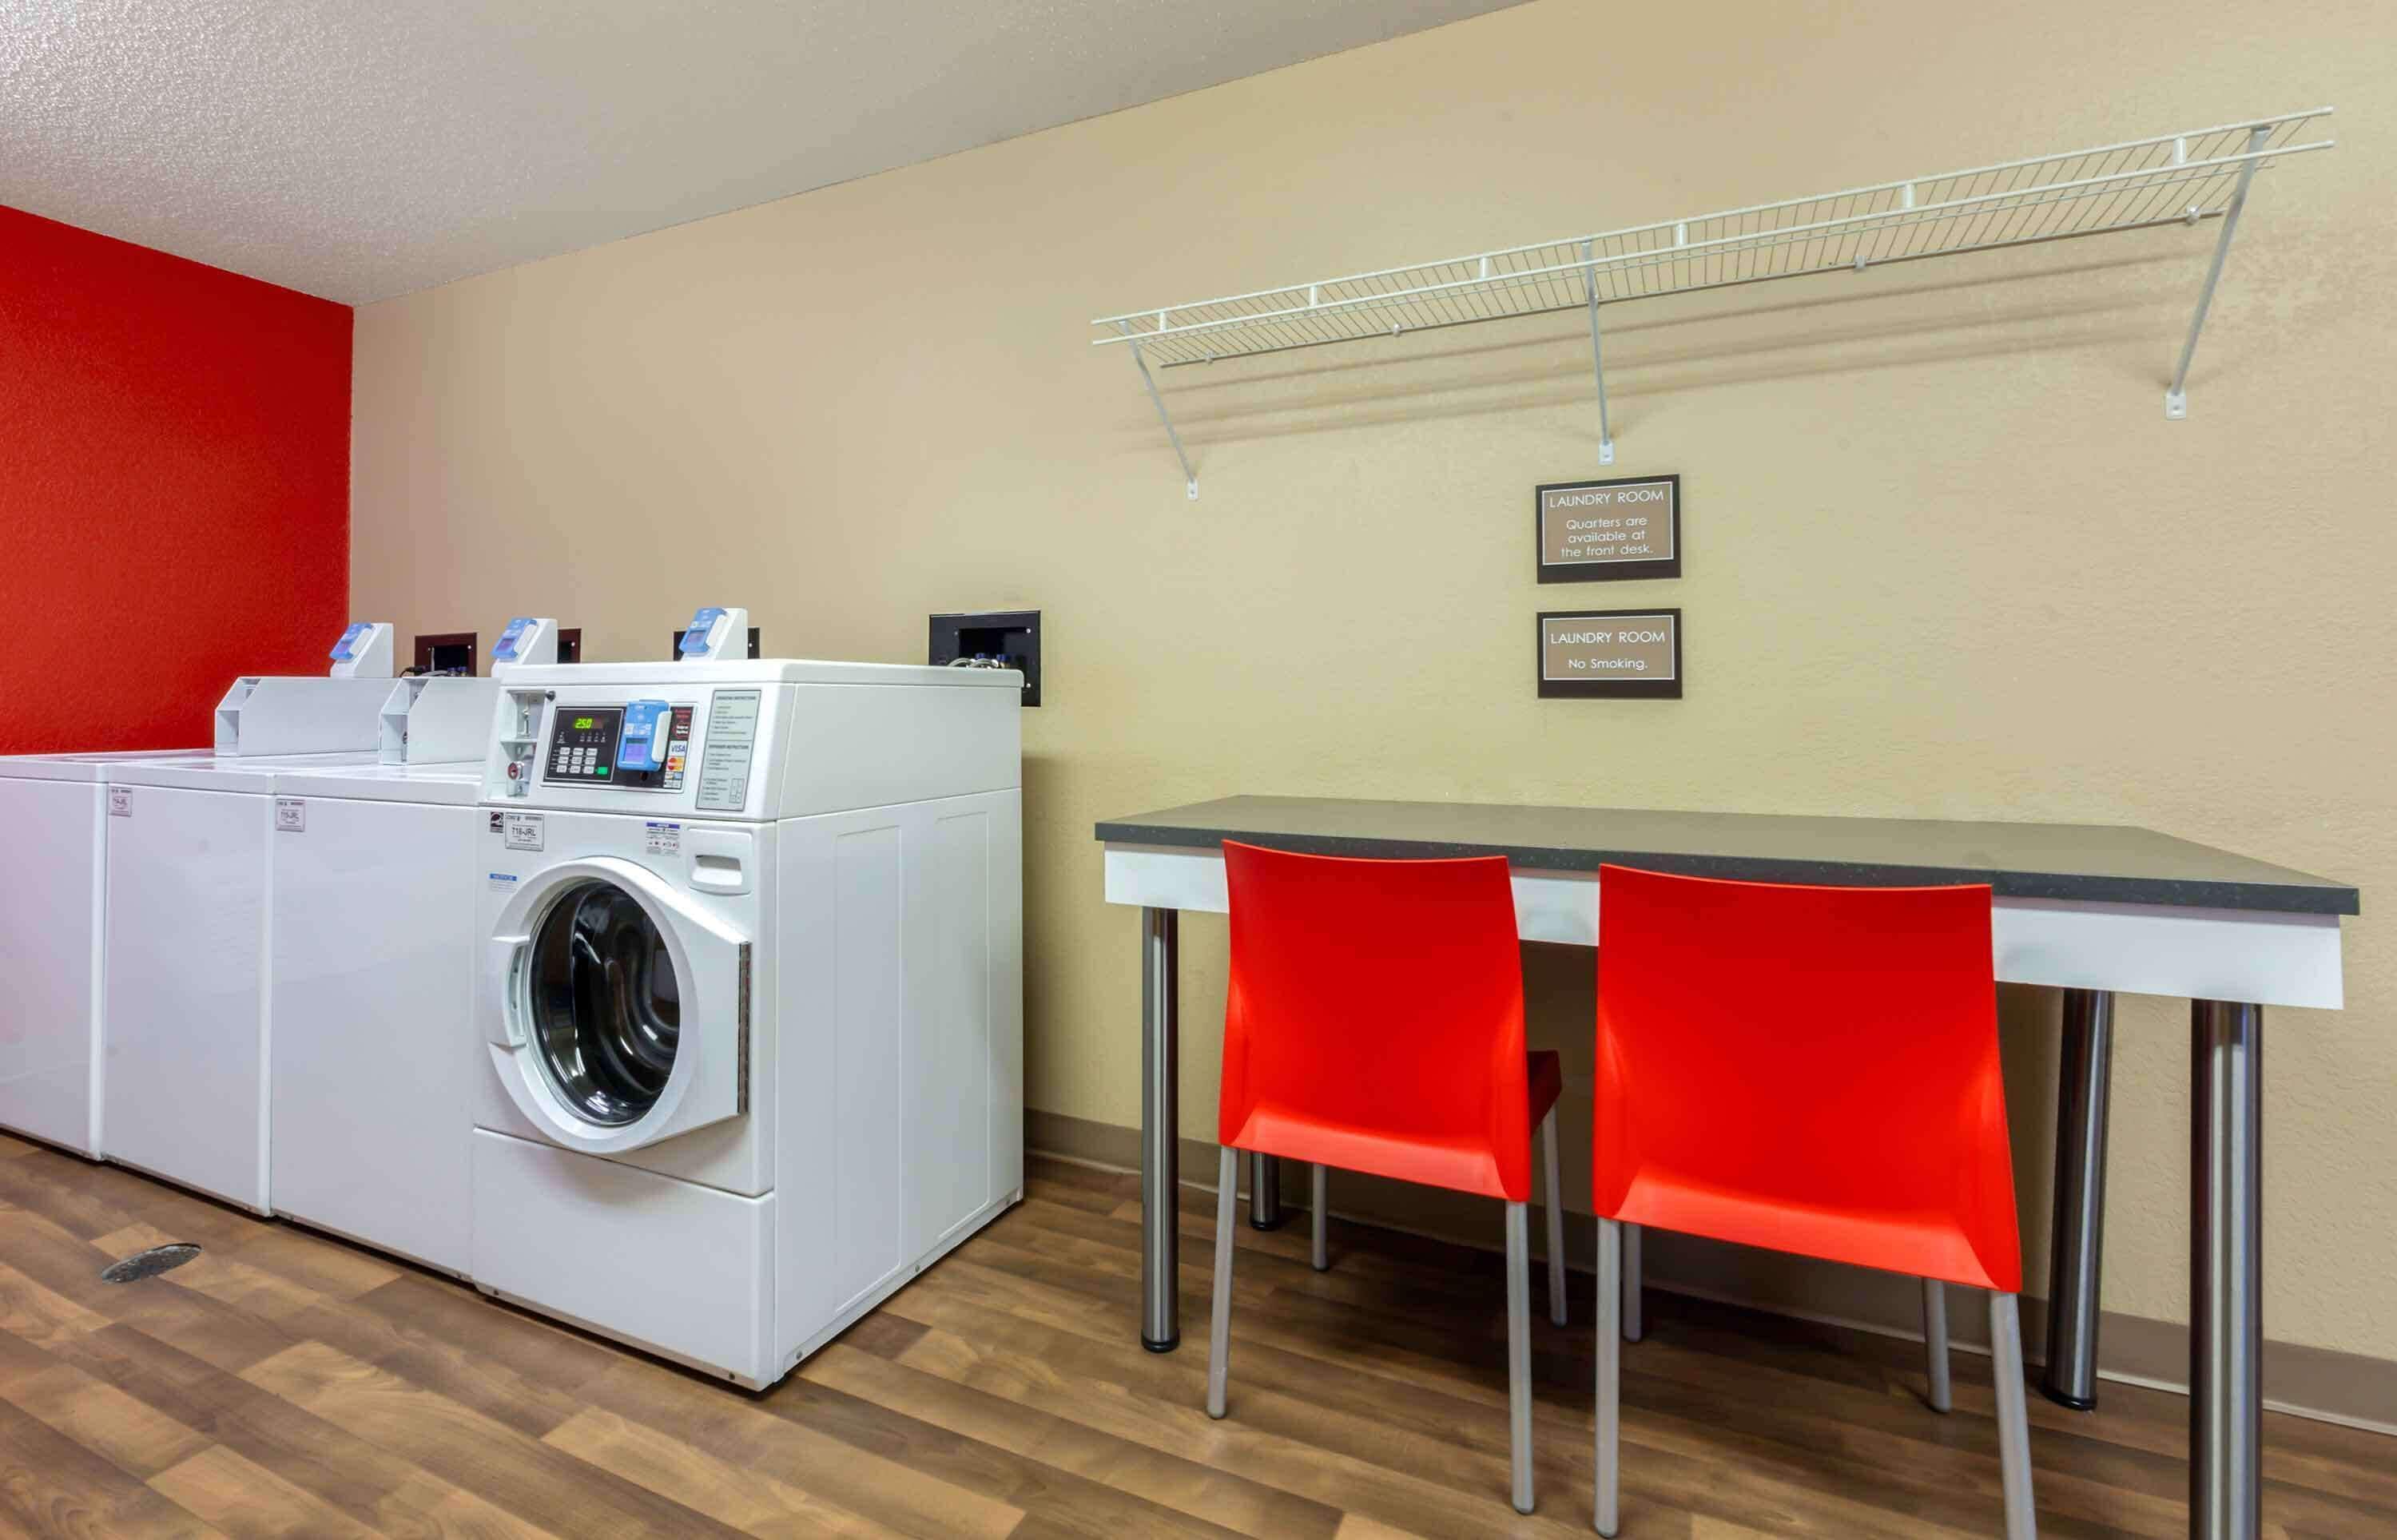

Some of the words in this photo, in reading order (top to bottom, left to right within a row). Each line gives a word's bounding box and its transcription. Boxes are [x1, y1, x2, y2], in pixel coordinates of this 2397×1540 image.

[1549, 493, 1612, 508] LAUNDRY
[1617, 490, 1664, 503] ROOM
[1566, 518, 1621, 530] Quarters
[1625, 517, 1648, 526] are
[1568, 531, 1626, 544] available
[1631, 530, 1646, 541] at
[1560, 547, 1581, 558] the
[1586, 545, 1615, 556] front
[1620, 544, 1654, 555] desk.
[1551, 632, 1612, 645] LAUNDRY
[1619, 631, 1665, 643] ROOM
[1568, 659, 1586, 669] No
[1591, 658, 1648, 671] Smoking.
